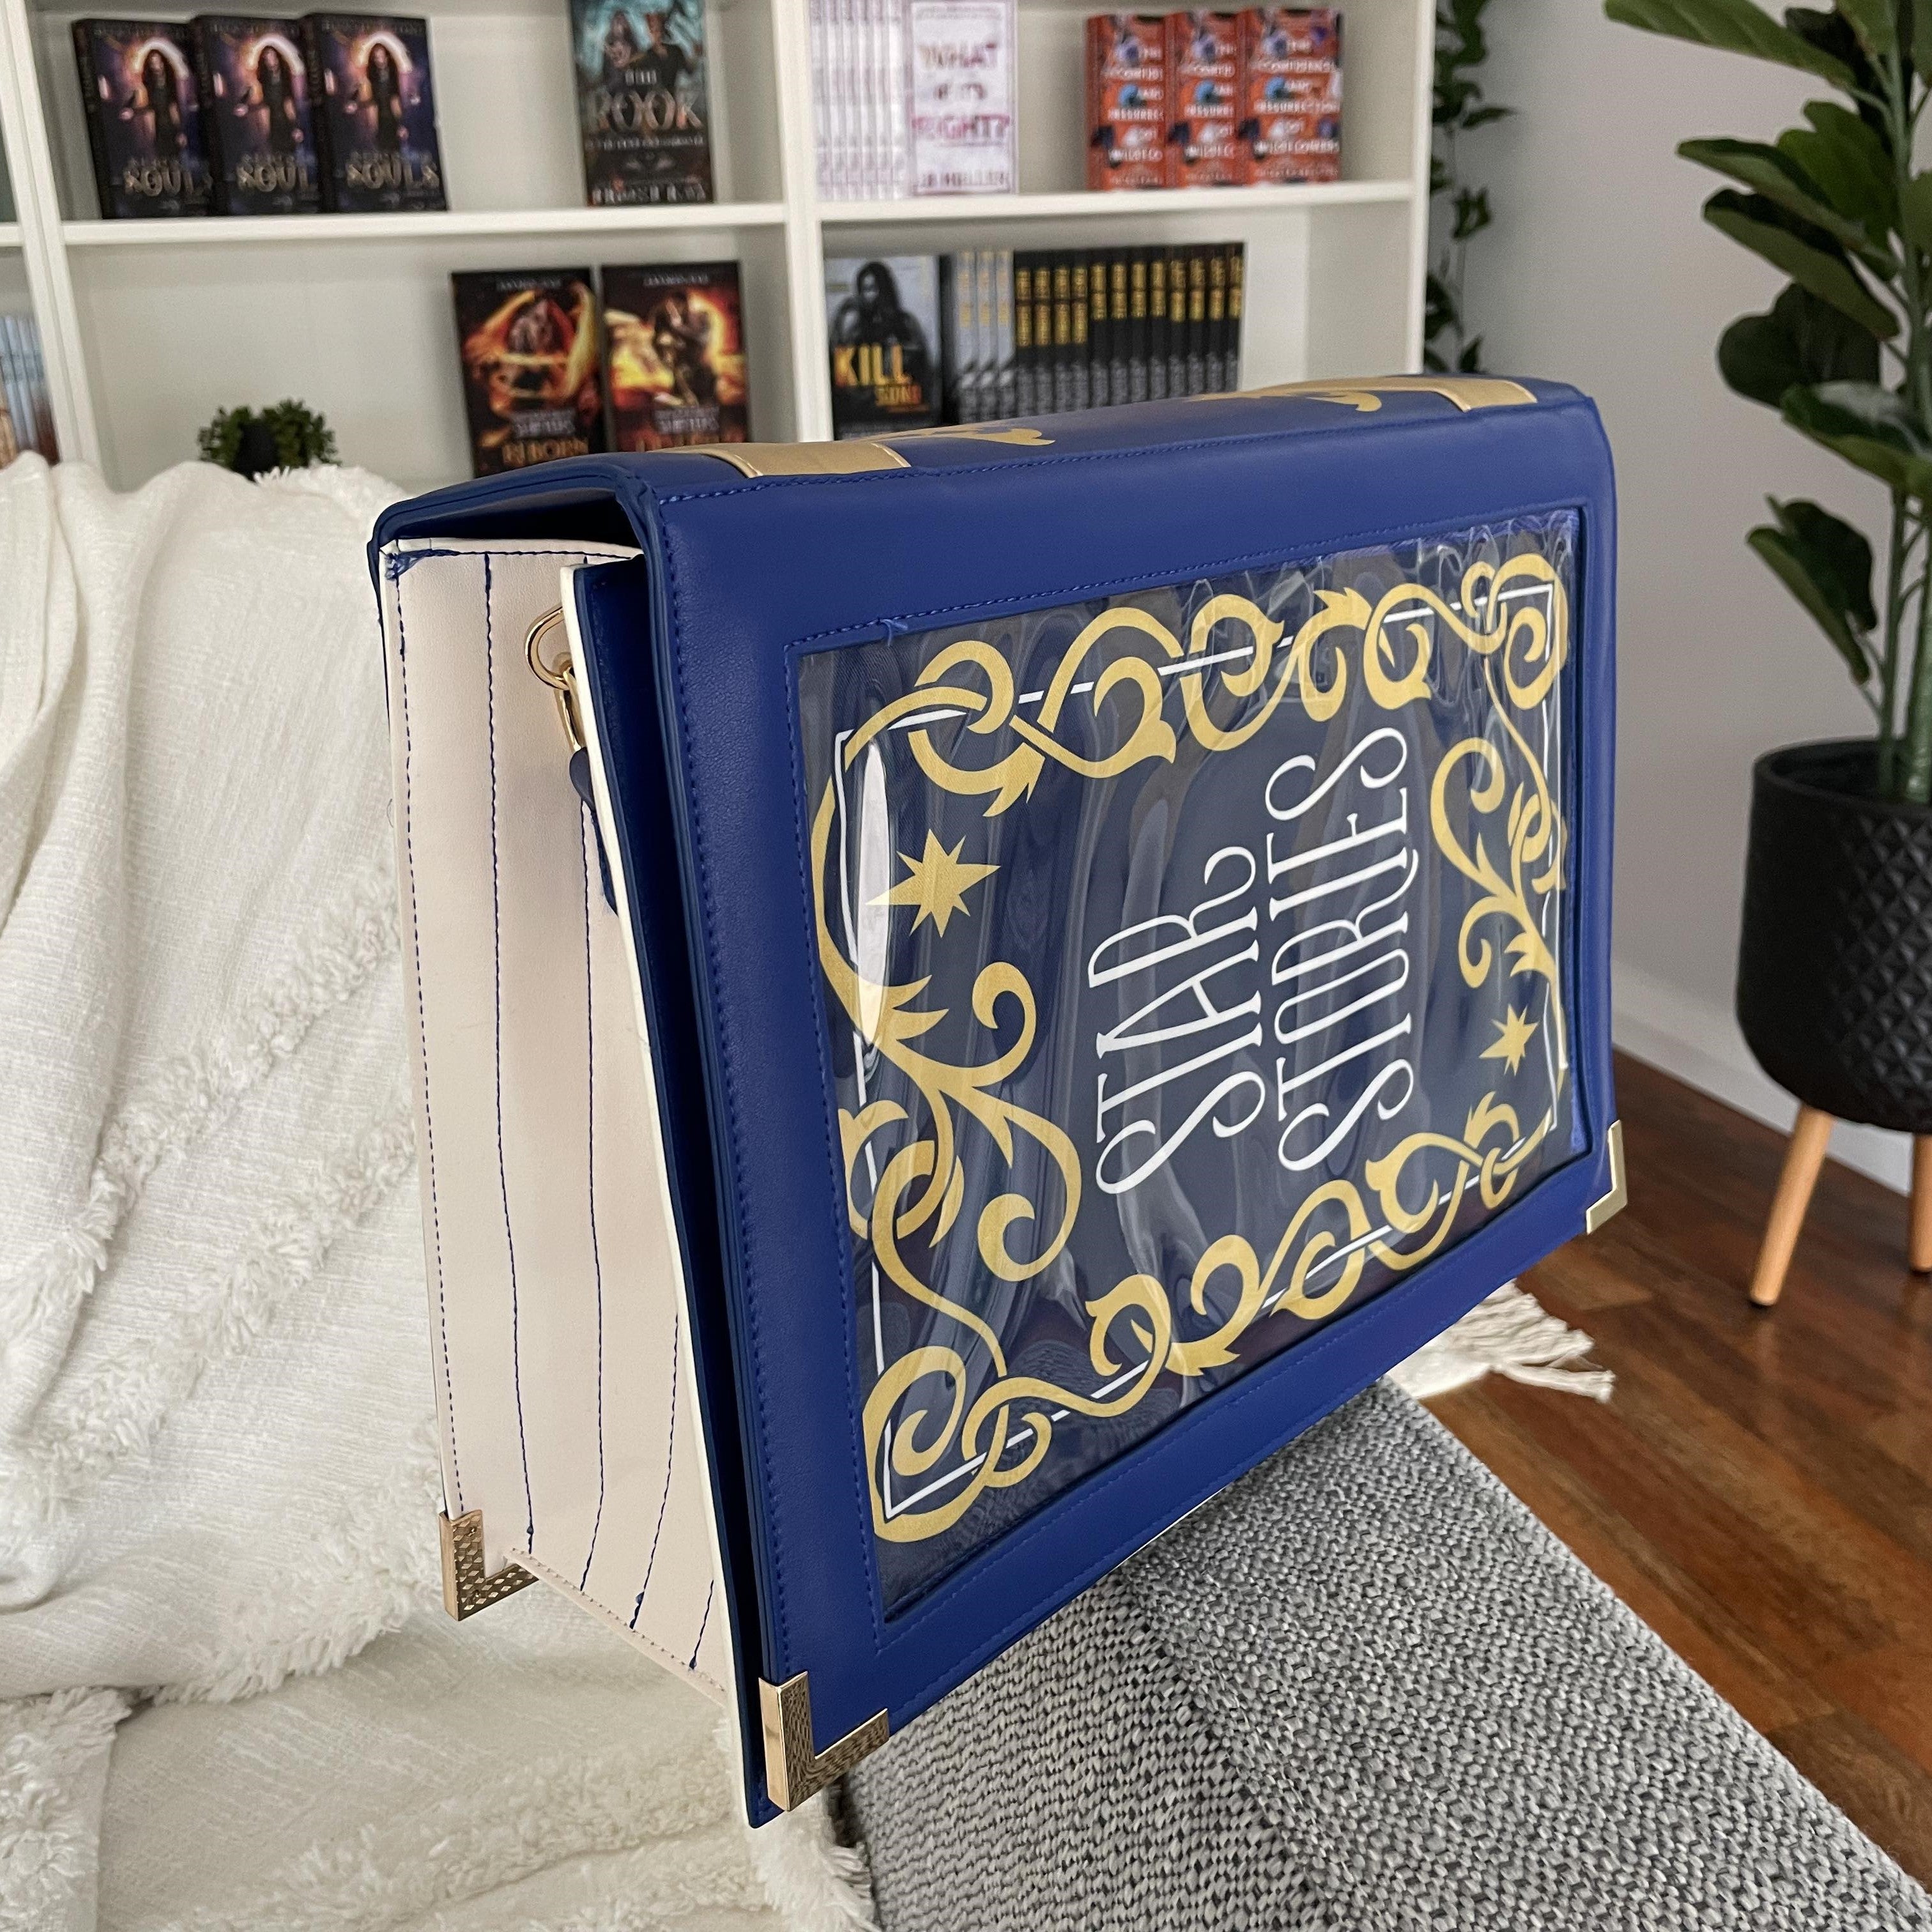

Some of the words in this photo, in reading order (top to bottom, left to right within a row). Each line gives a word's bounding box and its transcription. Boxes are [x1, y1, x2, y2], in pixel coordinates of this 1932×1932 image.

[584, 89, 702, 130] ROOK
[346, 159, 440, 189] SOULS
[834, 344, 912, 386] KILL
[1265, 727, 1419, 1171] STORIES
[1088, 847, 1266, 1194] STAR
